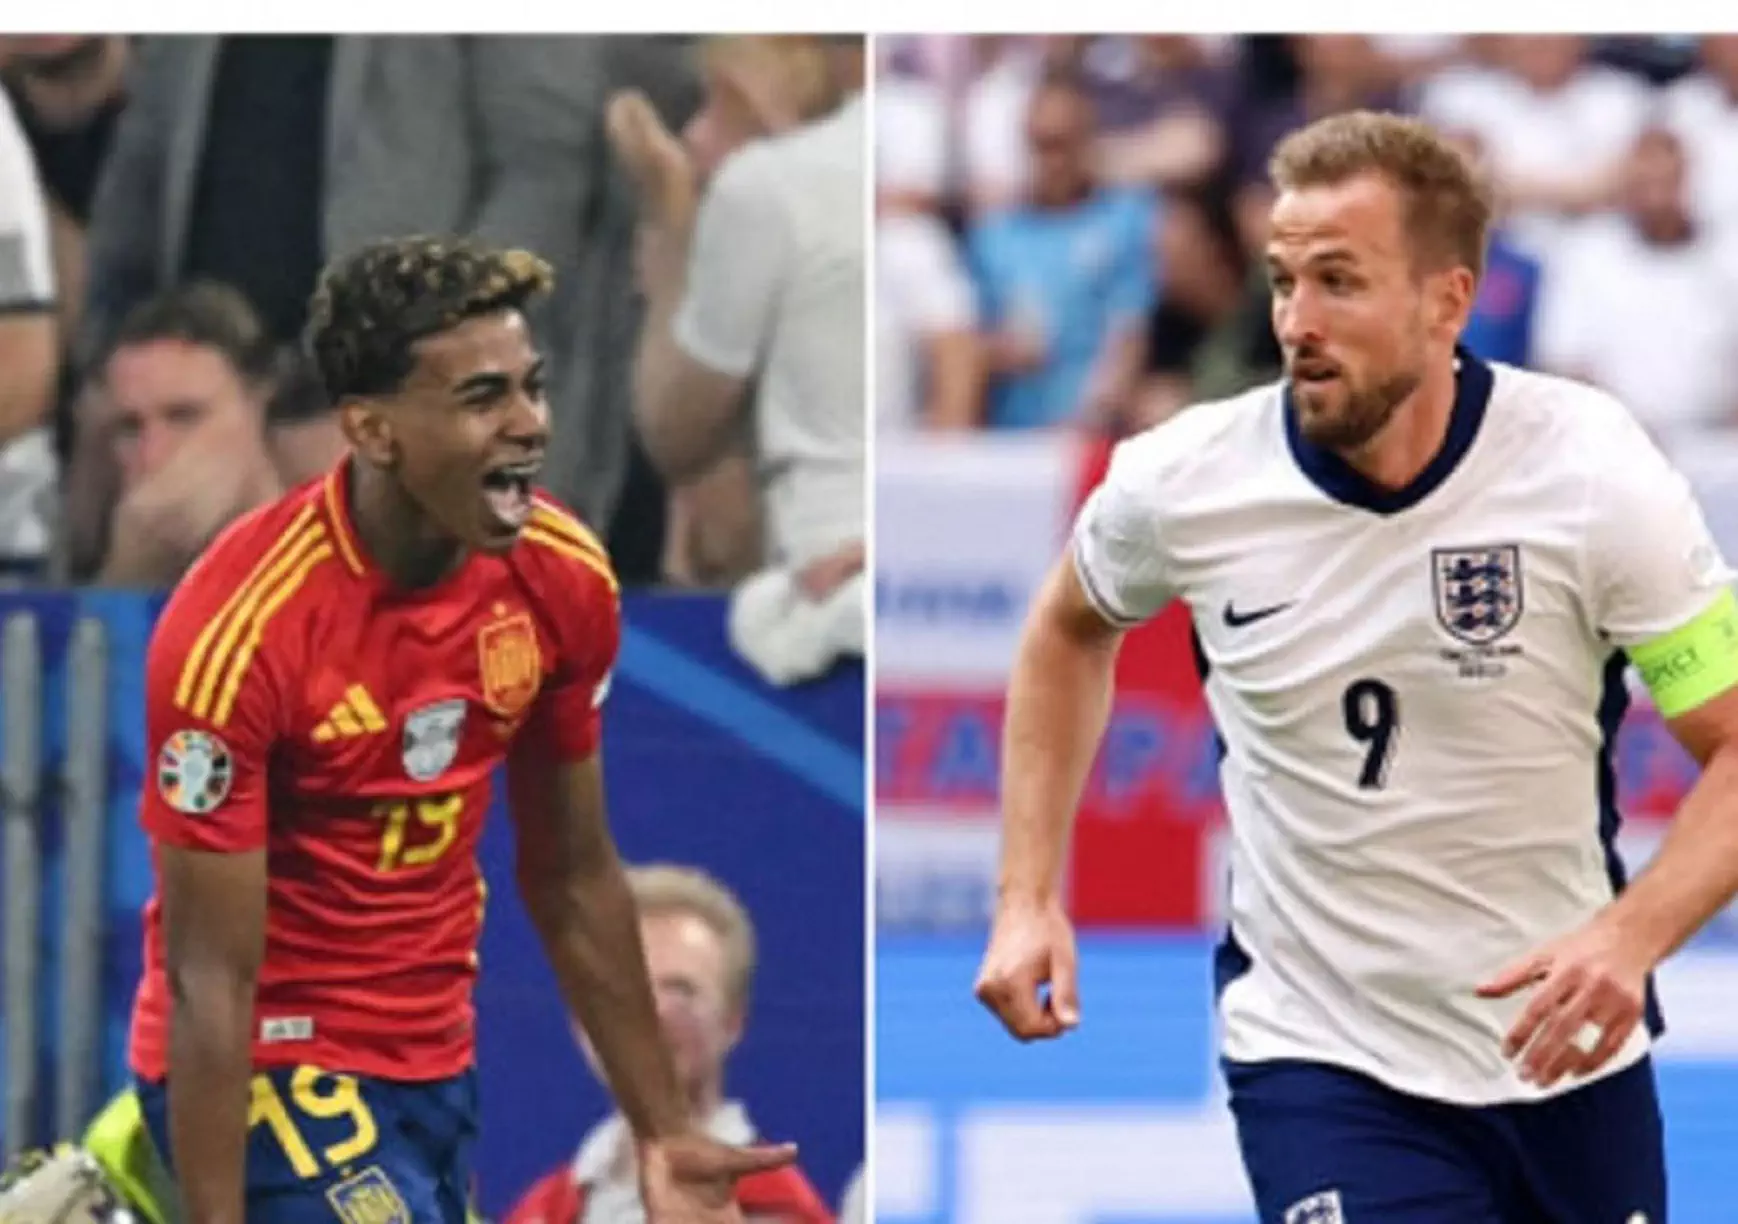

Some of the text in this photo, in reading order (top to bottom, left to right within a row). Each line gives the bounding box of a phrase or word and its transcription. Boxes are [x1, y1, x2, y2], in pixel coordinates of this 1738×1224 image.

[1341, 678, 1399, 790] 9
[371, 794, 464, 873] 19
[248, 1064, 379, 1178] 19
